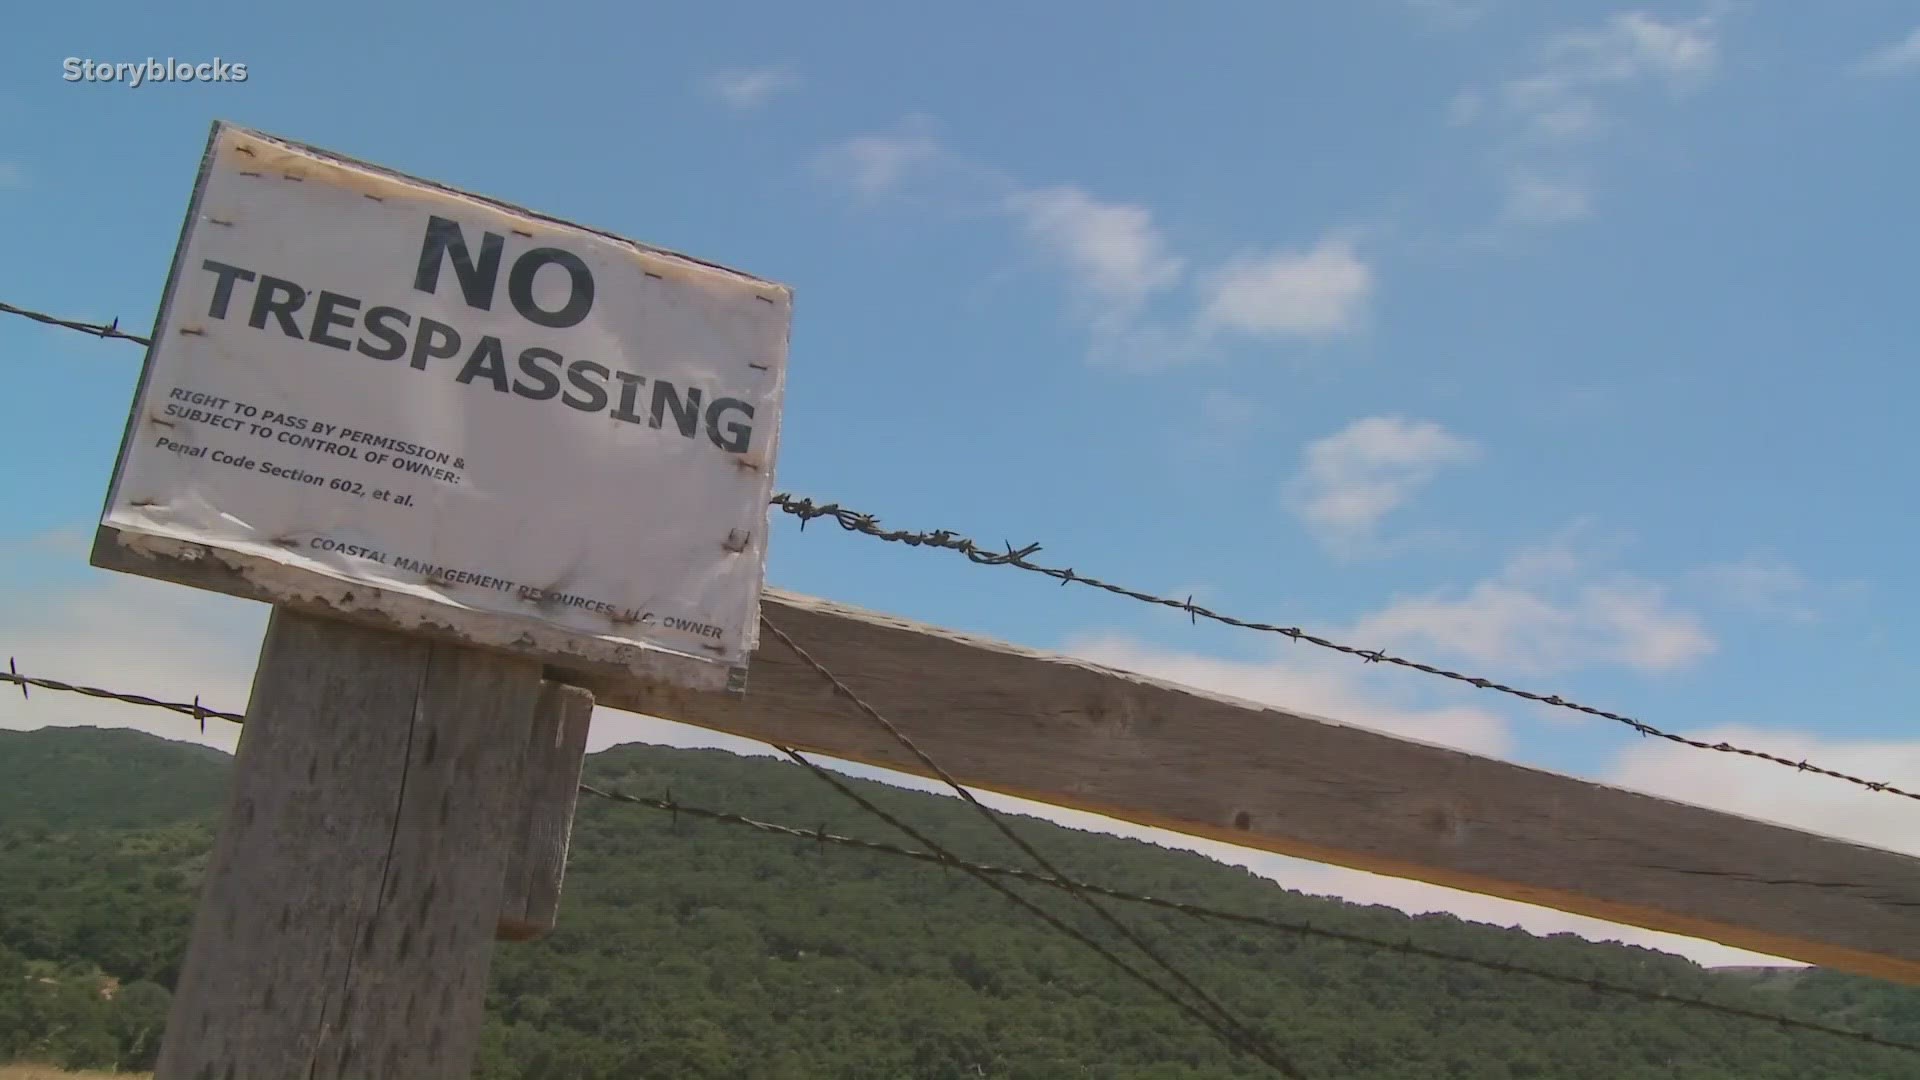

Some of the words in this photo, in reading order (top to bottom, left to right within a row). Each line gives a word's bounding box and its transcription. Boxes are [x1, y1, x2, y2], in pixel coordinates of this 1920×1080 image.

[413, 215, 595, 328] NO
[203, 260, 755, 453] TRESPASSING
[156, 437, 207, 458] Penal
[211, 450, 255, 470] Code
[259, 462, 324, 487] Section
[330, 478, 366, 498] 602,
[372, 488, 391, 502] et
[394, 494, 415, 508] al.
[164, 404, 242, 432] SUBJECT
[250, 424, 273, 439] TO
[277, 431, 358, 460] CONTROL
[364, 452, 389, 466] OF
[392, 458, 461, 484] OWNER:
[169, 387, 230, 410] RIGHT
[234, 402, 257, 417] TO
[261, 410, 308, 430] PASS
[312, 422, 337, 436] BY
[339, 428, 450, 465] PERMISSION
[453, 457, 465, 469] &
[310, 537, 387, 564] COASTAL
[393, 556, 515, 593] MANAGEMENT
[663, 617, 723, 639] OWNER
